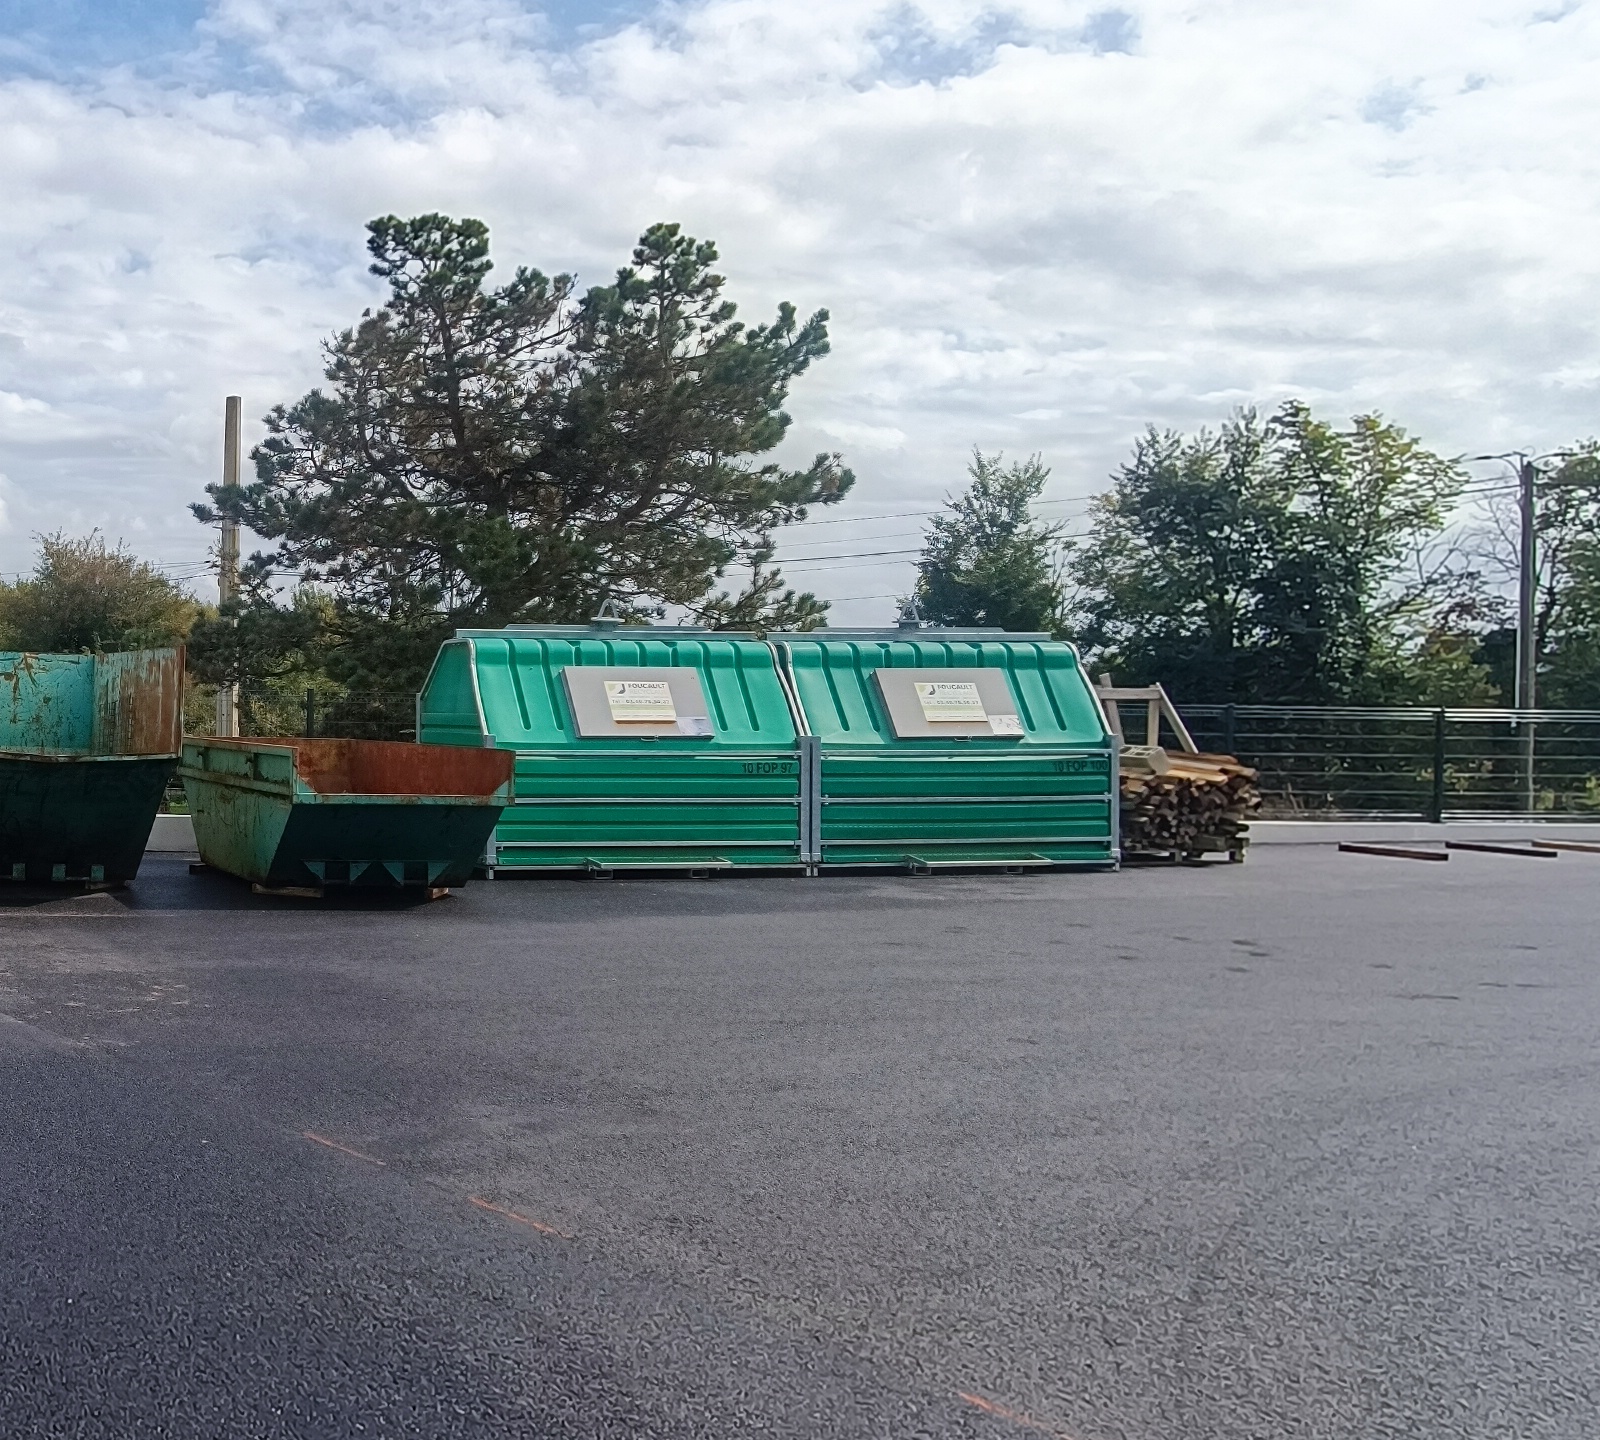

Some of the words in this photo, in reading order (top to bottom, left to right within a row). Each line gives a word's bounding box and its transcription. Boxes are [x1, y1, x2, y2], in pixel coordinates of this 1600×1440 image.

[742, 762, 753, 773] 10
[756, 762, 778, 773] FOP
[781, 762, 793, 773] 97
[1066, 760, 1088, 771] FOP
